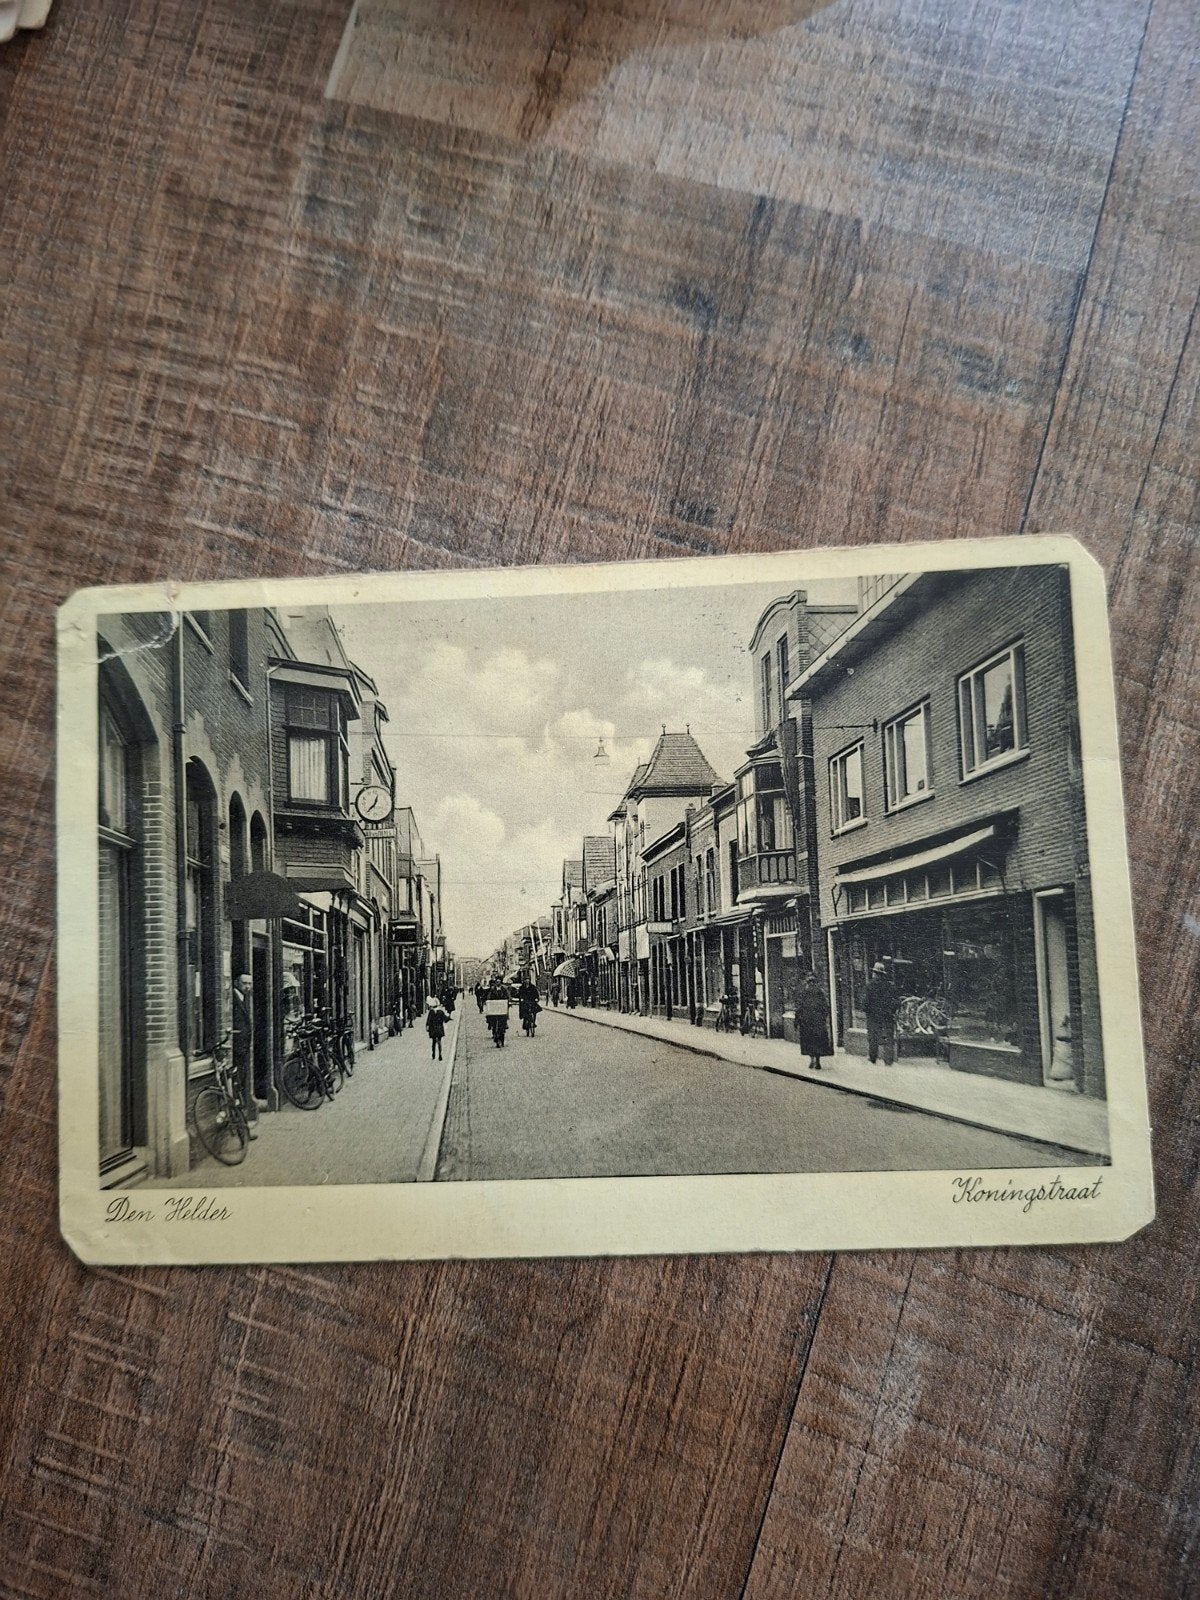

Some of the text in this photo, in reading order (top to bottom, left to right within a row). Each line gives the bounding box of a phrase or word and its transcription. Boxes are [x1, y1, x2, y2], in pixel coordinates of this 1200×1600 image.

[105, 1196, 232, 1223] Den Helder
[952, 1175, 1102, 1213] Koningstraat
